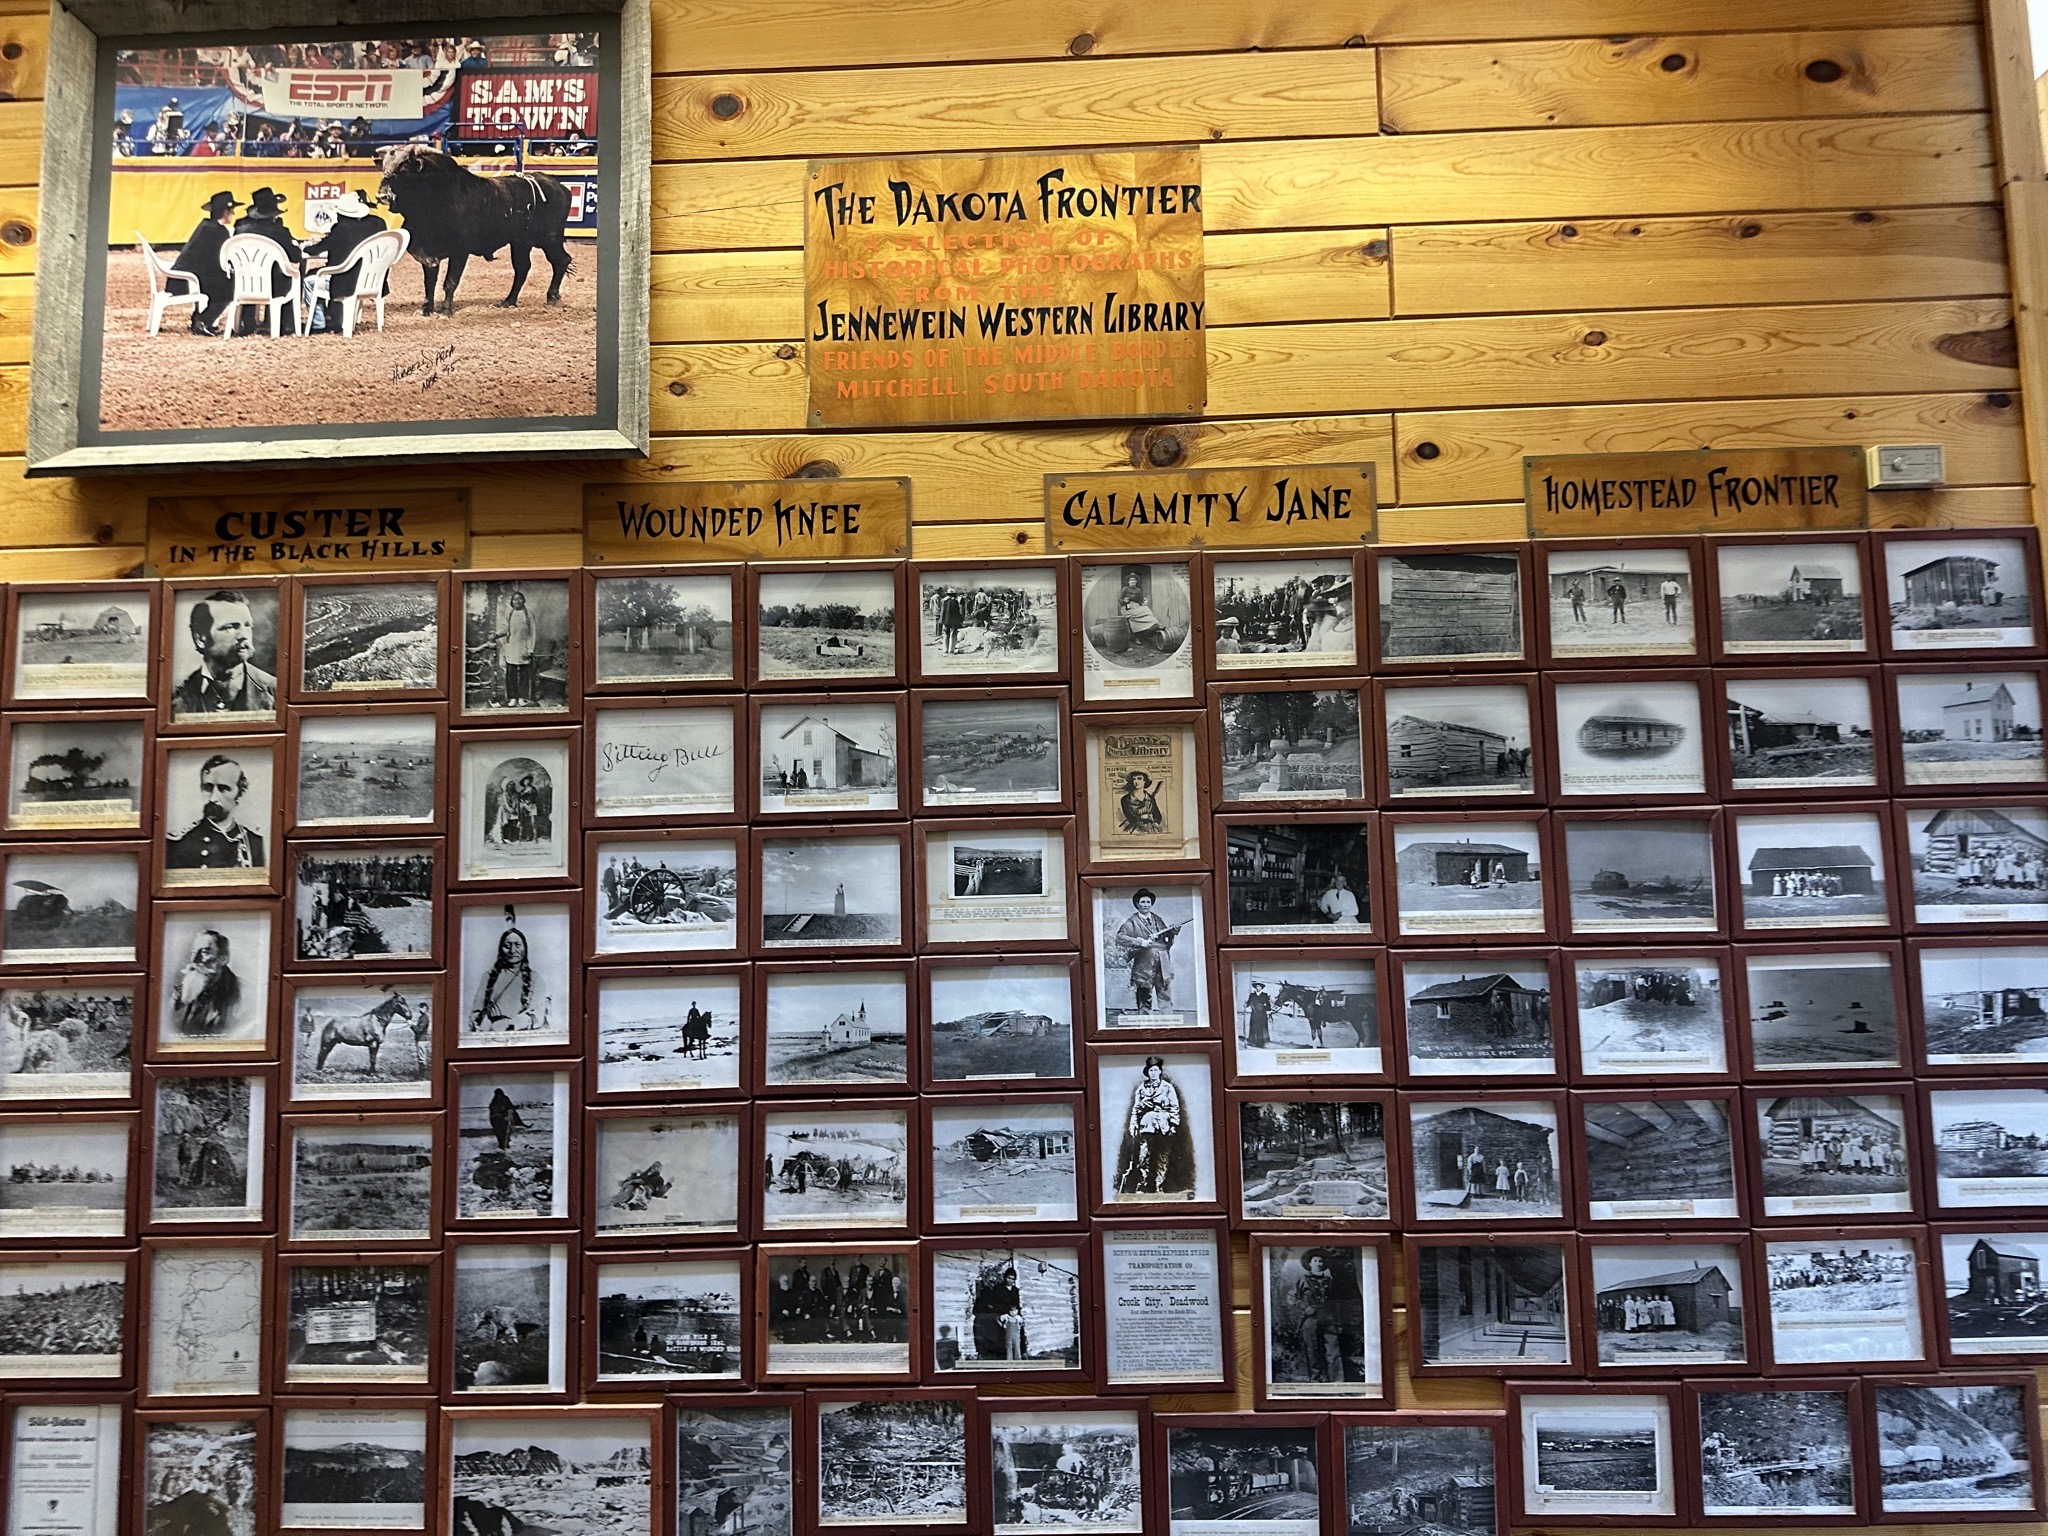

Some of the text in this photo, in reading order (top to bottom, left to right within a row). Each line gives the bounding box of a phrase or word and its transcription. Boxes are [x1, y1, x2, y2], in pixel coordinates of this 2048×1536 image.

[289, 73, 393, 101] ESPN
[470, 79, 586, 104] SAM'S
[466, 106, 589, 131] TOWN
[307, 186, 341, 199] NFR
[814, 168, 1201, 241] THE DAKOTA FRONTIER
[867, 229, 1112, 253] A SELECTION OF
[822, 250, 1192, 280] HISTORICAL PHOTOGRAPHS
[898, 282, 1055, 303] FROM THE
[813, 292, 1205, 343] JENNEWEIN WESTERN LIBRARY
[823, 340, 1199, 371] FRIENDS OF THE MIDDLE BORDER
[984, 371, 1064, 395] SOUTH
[1078, 367, 1175, 390] DAKOTA
[1062, 477, 1353, 529] CALAMITY JANE
[1541, 467, 1840, 516] HOMESTEAD FRONTIER
[214, 508, 406, 541] CUSTER
[615, 498, 862, 547] WOUNDED KNEE
[169, 539, 446, 564] IN THE BLACK HILLS
[1169, 1296, 1210, 1306] Deadwood
